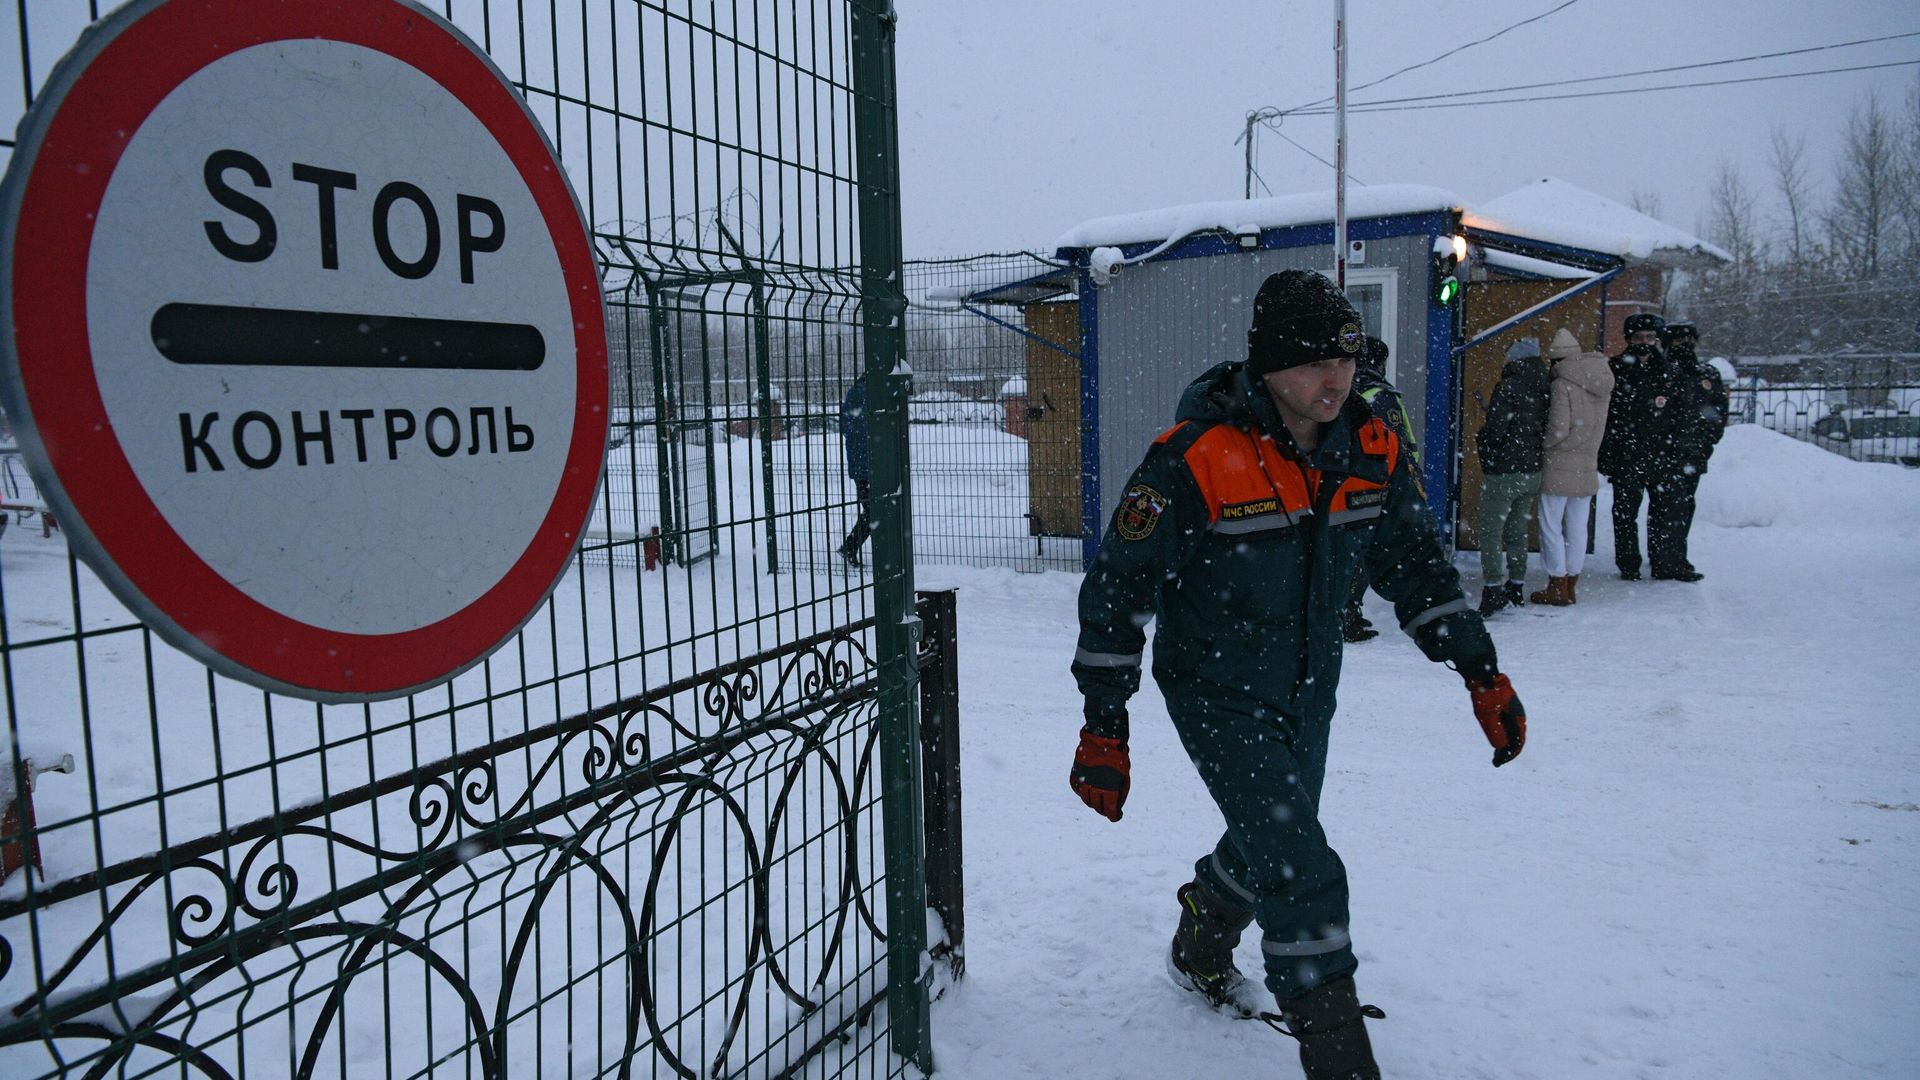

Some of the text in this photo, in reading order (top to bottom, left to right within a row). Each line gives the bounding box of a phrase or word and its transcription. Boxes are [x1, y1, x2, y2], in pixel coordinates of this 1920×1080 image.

[203, 148, 506, 284] STOP
[178, 406, 535, 473] КОНТРОЛЬ
[1223, 500, 1277, 518] МЧС РОССИИ
